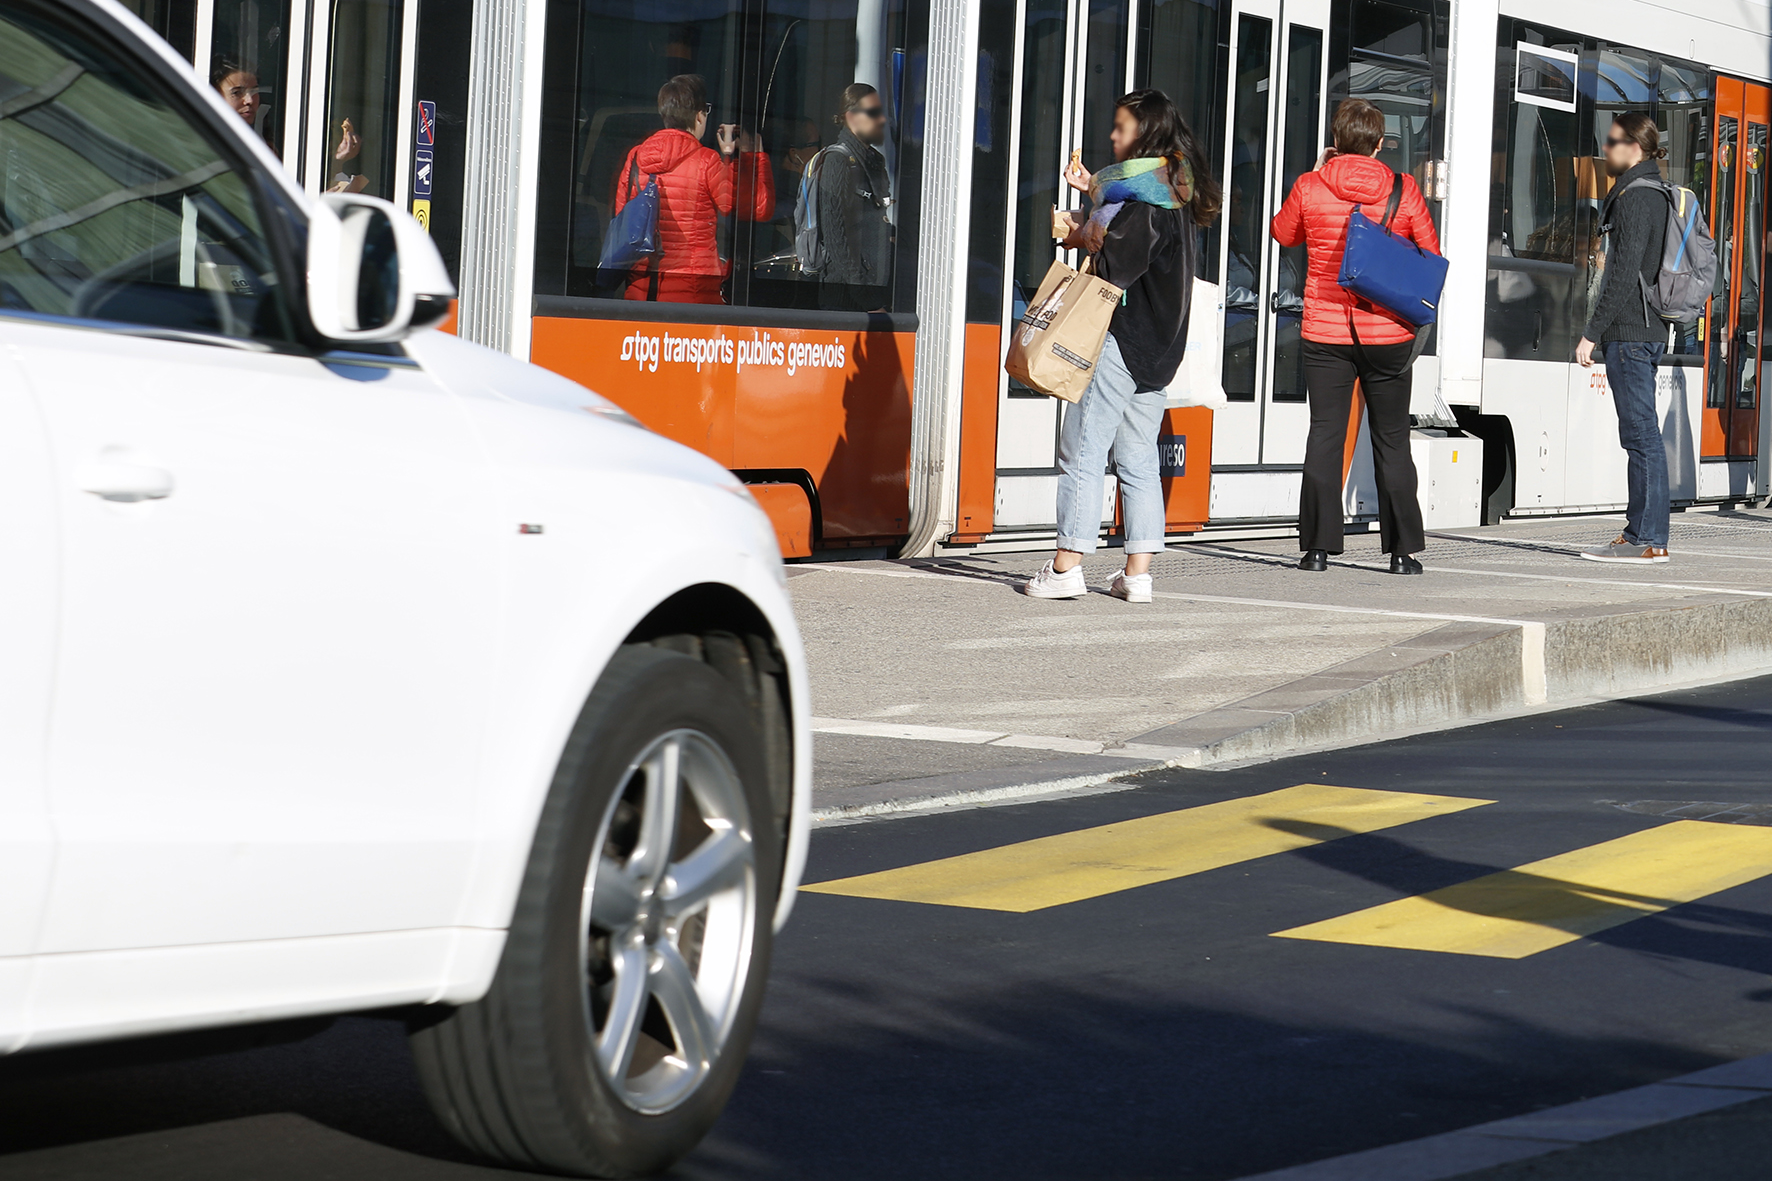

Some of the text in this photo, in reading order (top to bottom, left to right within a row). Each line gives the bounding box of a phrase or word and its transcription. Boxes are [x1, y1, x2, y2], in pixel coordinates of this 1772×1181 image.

[634, 330, 846, 376] tpg transports publics genevois
